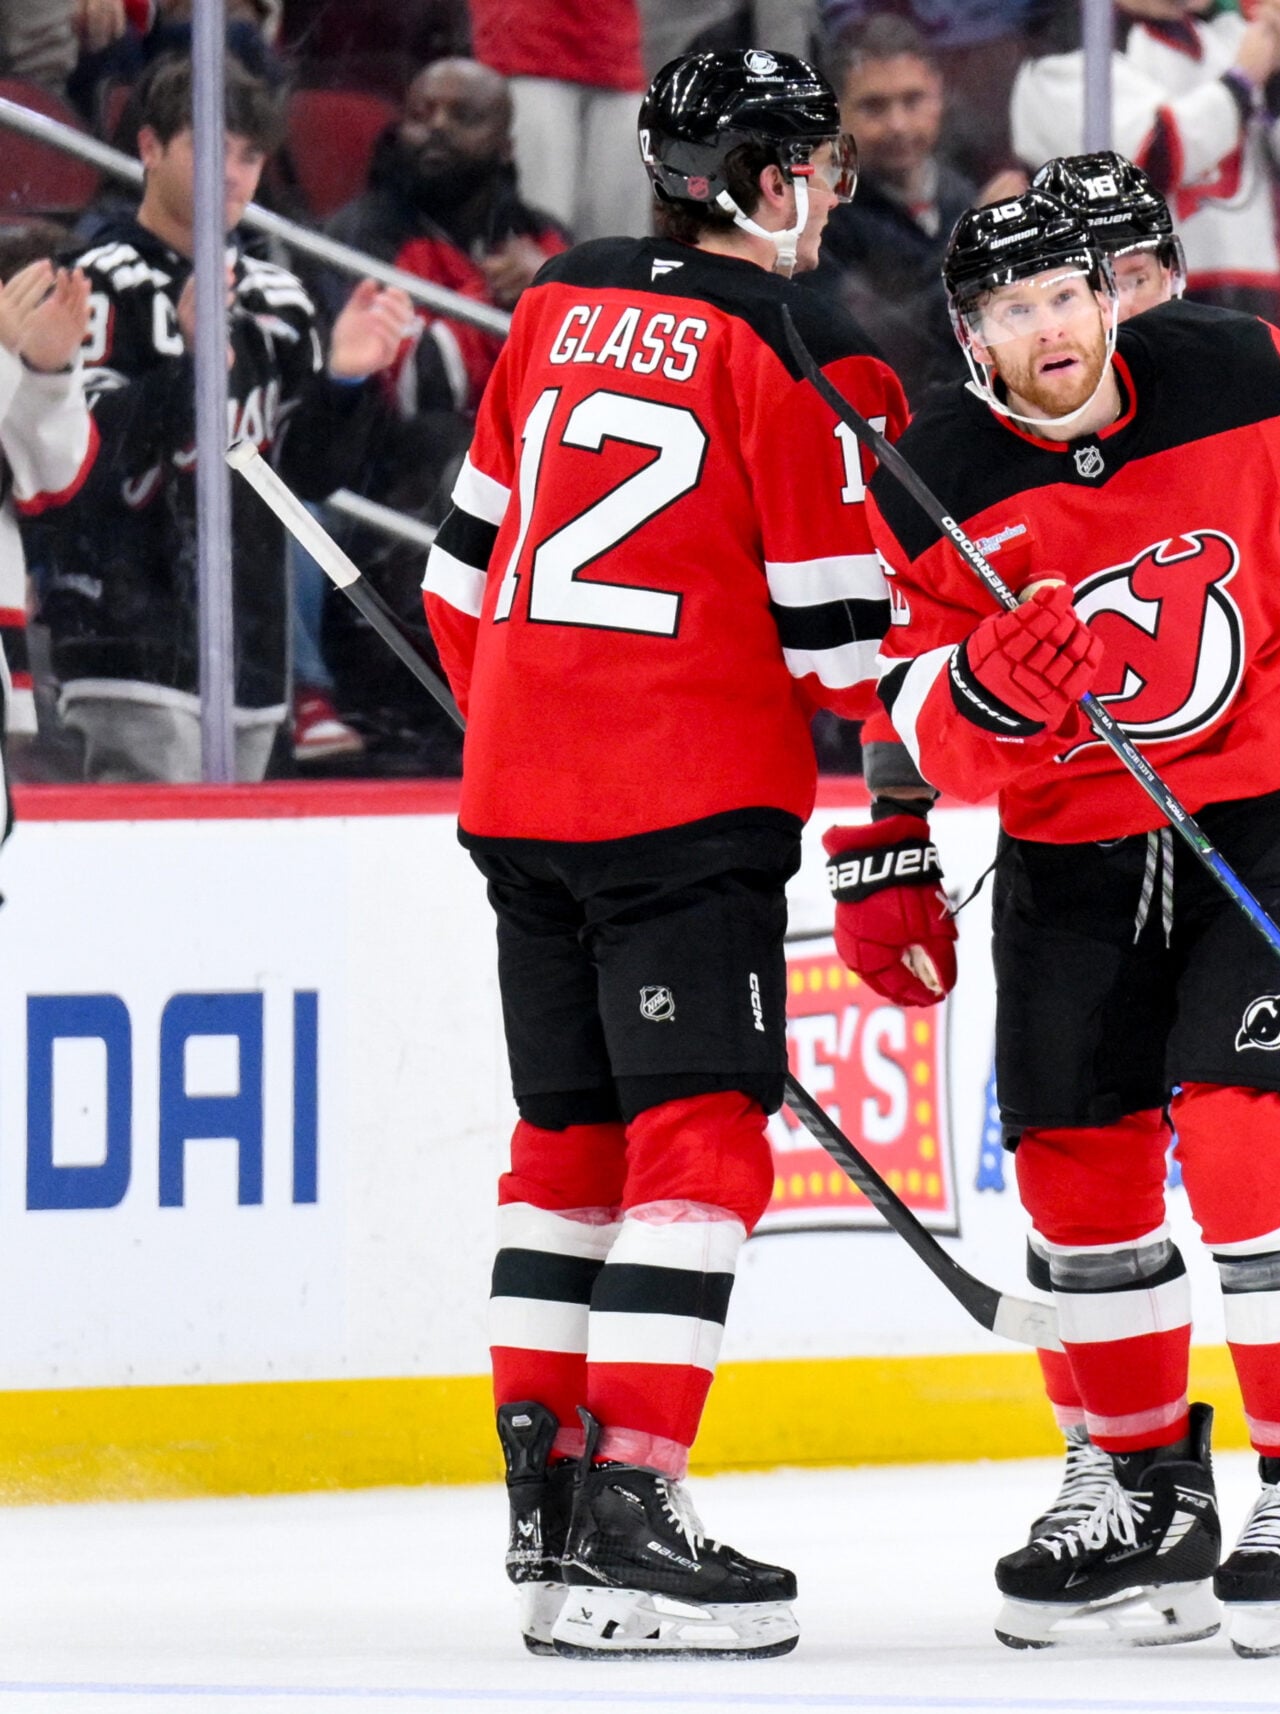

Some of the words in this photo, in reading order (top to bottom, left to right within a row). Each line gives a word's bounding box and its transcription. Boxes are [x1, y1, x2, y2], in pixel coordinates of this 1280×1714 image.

[989, 202, 1023, 223] 10
[1083, 174, 1119, 200] 18
[548, 304, 709, 382] GLASS
[492, 386, 710, 639] 12
[941, 516, 1020, 610] SHERWOOD
[826, 845, 942, 891] BAUER
[750, 972, 765, 1032] CCM
[26, 990, 318, 1211] DAI
[785, 1003, 908, 1146] E'S
[647, 1540, 703, 1572] BAUER
